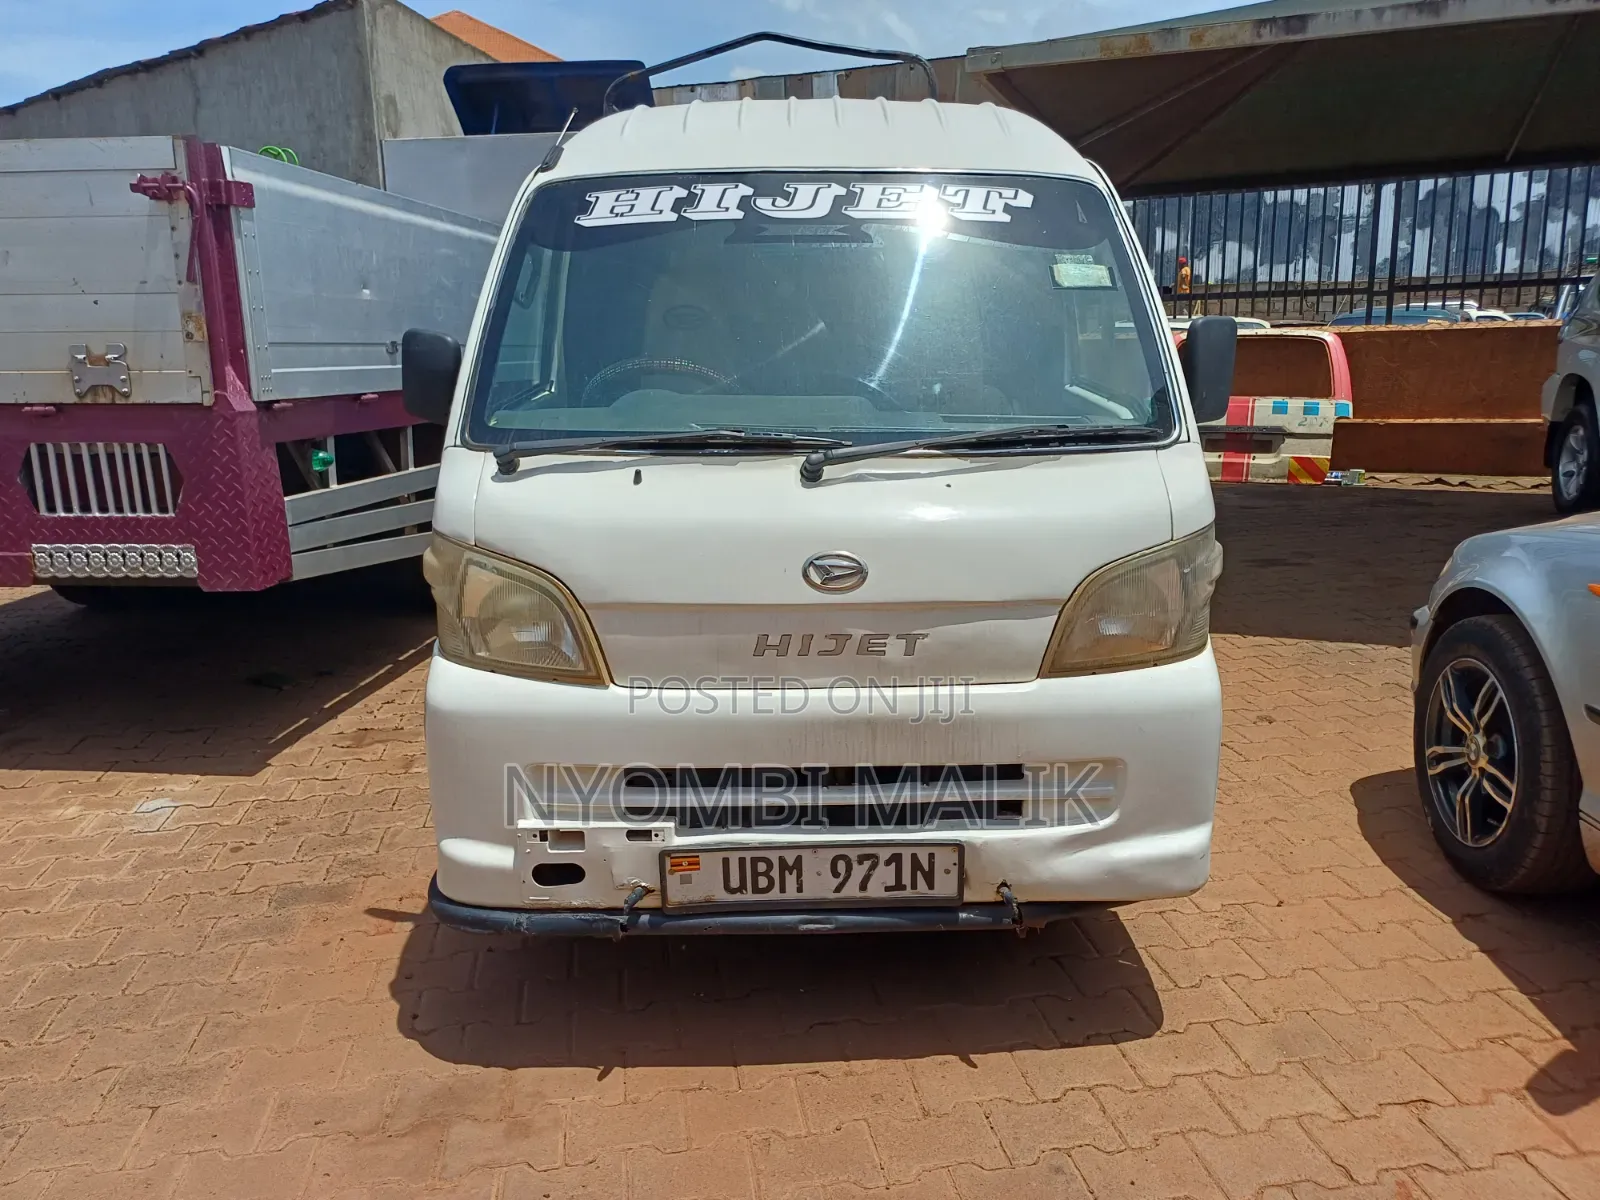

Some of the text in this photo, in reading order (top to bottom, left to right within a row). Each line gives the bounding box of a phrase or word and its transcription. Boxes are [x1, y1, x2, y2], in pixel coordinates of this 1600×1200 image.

[574, 182, 1035, 228] HIJET
[752, 633, 930, 657] HIJET
[722, 852, 937, 896] UBM 971N
